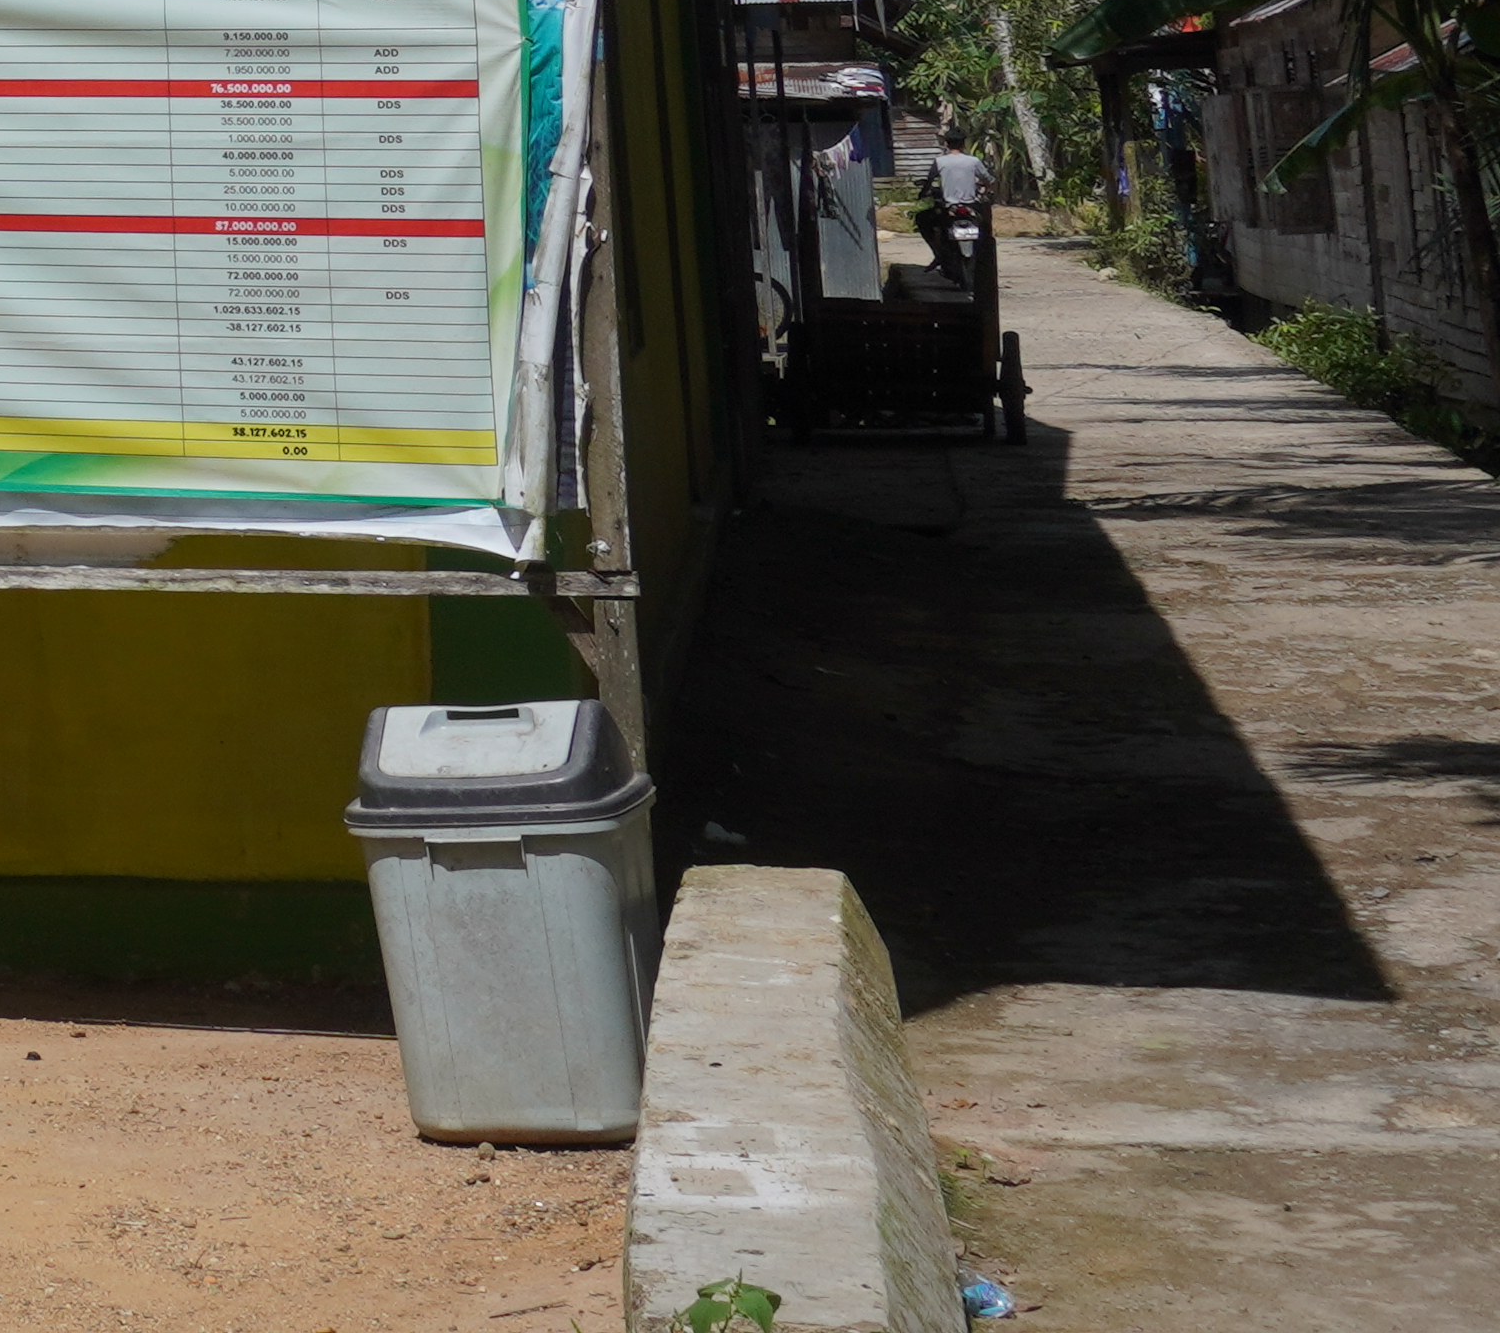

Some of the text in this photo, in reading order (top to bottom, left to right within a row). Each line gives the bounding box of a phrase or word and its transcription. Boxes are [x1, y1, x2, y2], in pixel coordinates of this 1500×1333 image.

[214, 305, 300, 316] 1.029.633.602.15
[232, 427, 307, 439] 38.127.602.15
[282, 446, 308, 456] 0.00
